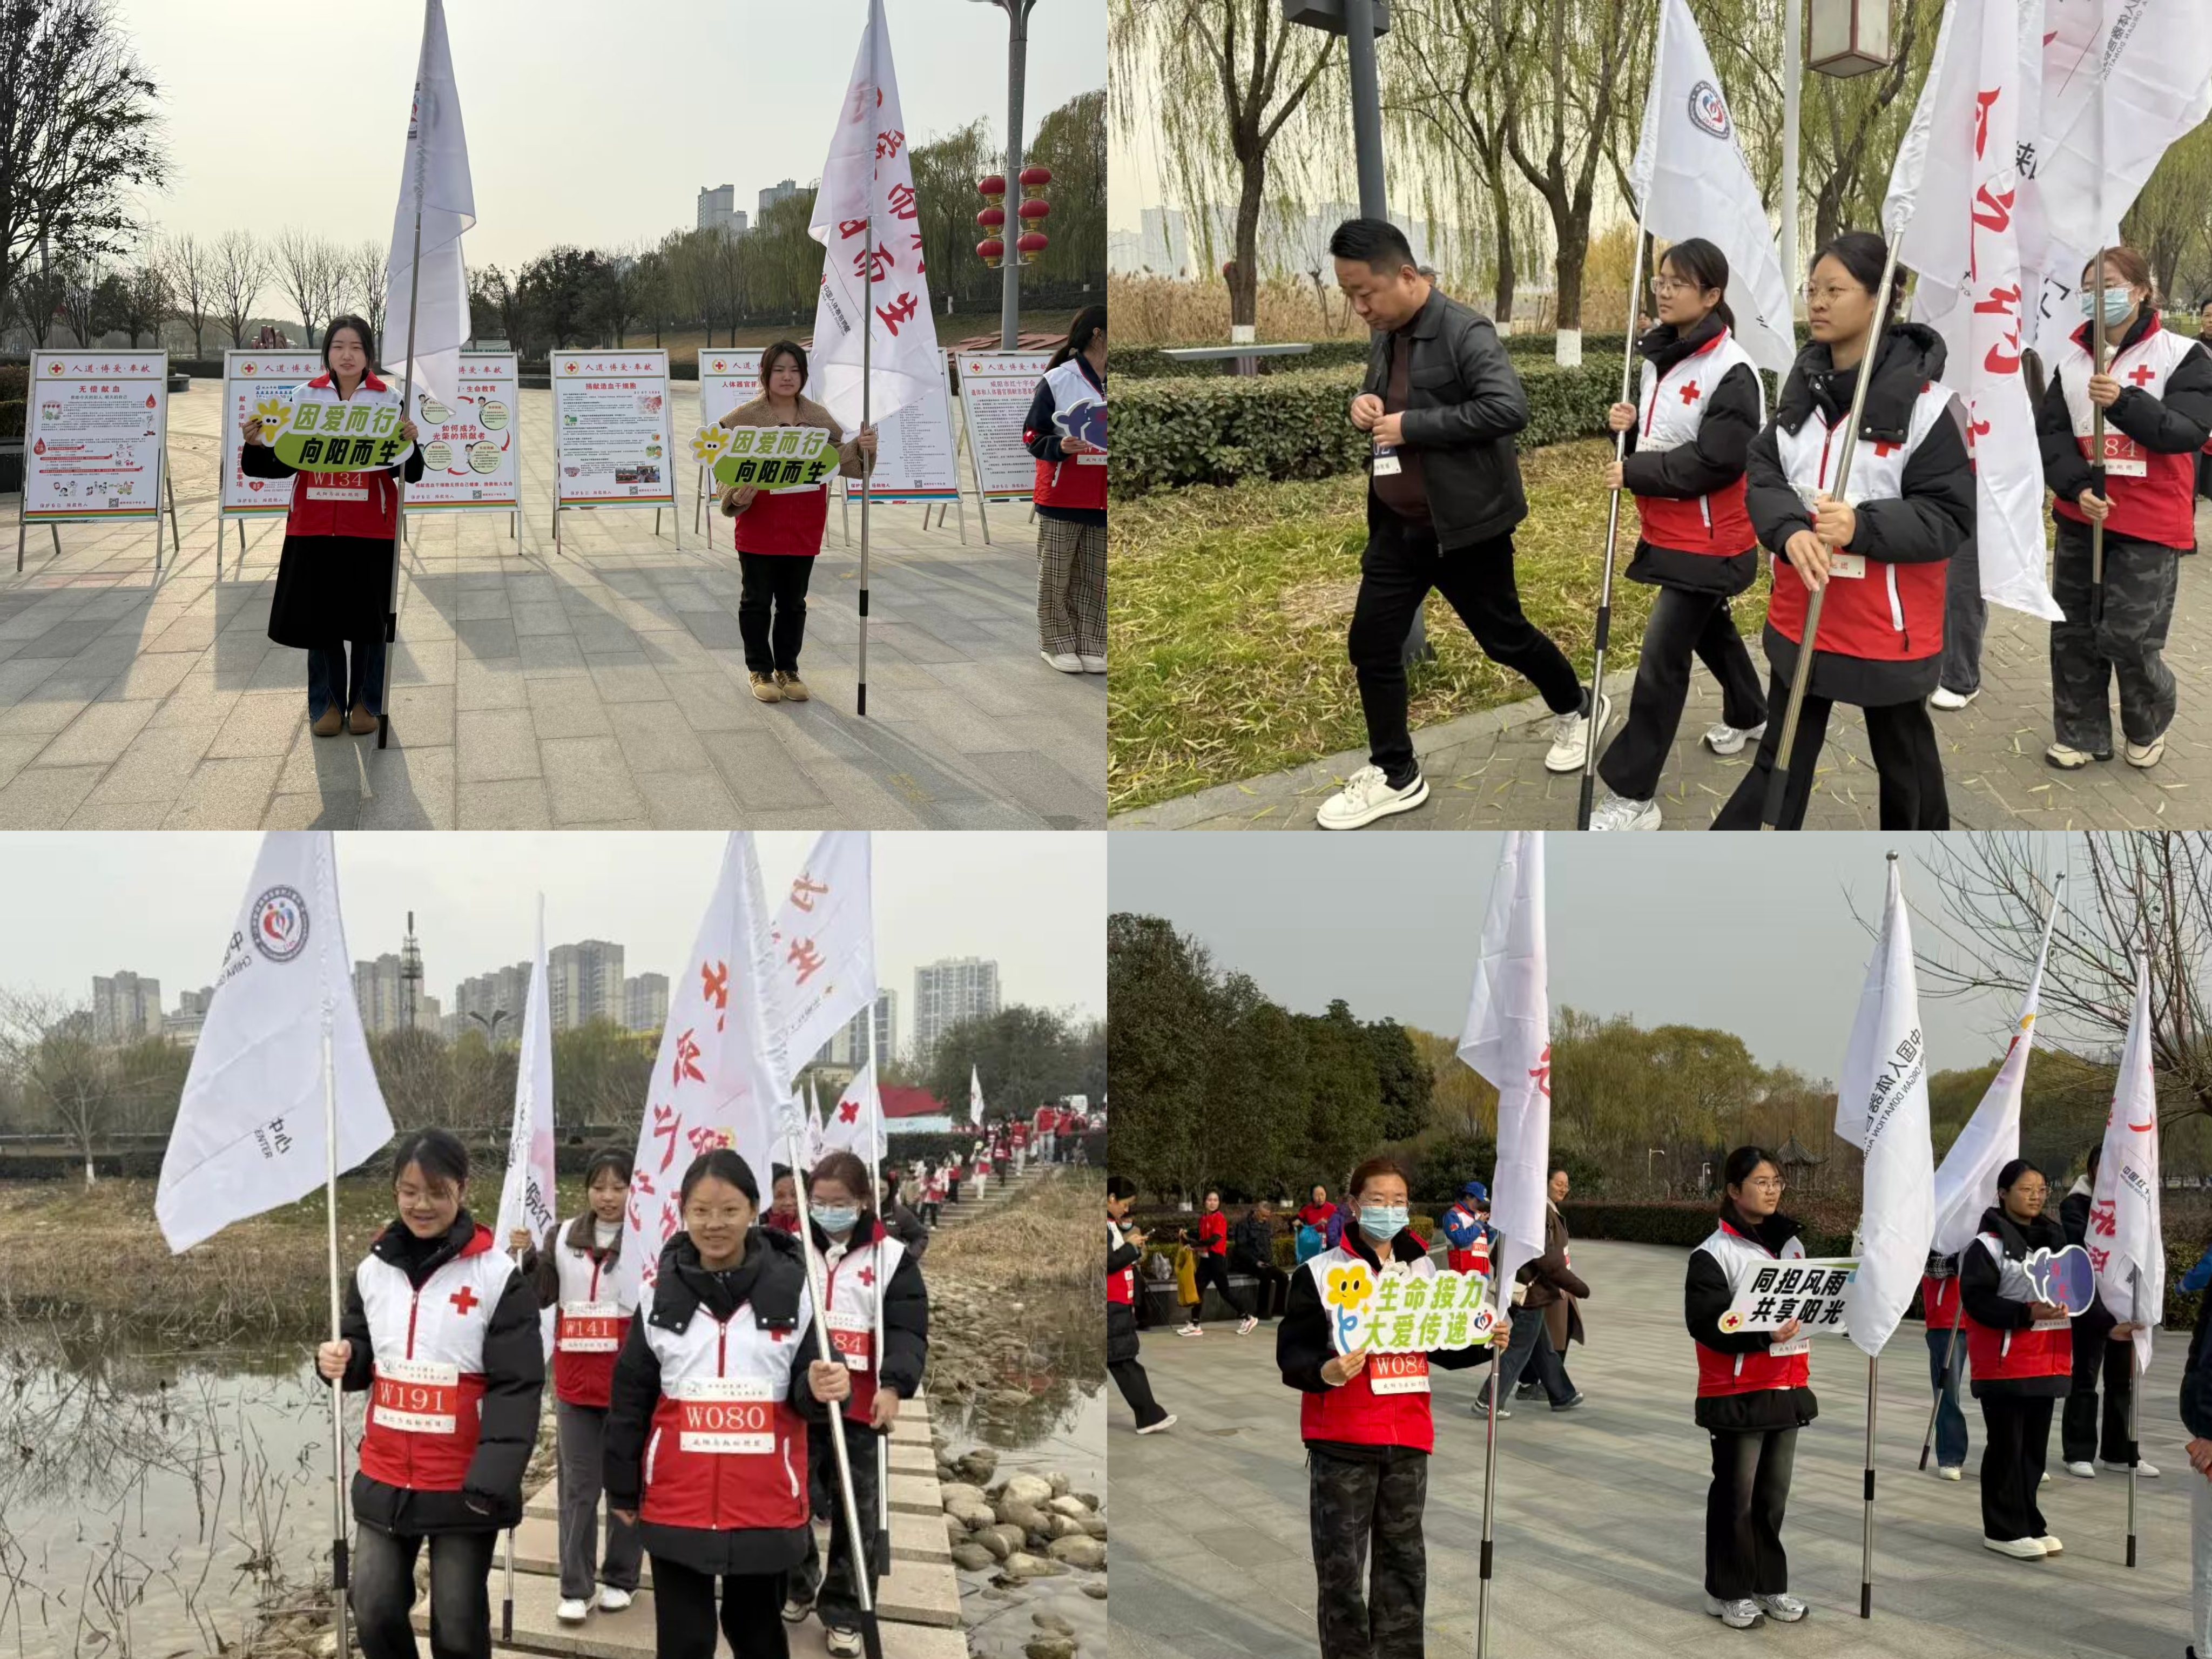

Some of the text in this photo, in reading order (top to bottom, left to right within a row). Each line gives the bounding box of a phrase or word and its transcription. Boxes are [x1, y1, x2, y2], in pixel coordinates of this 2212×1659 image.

[824, 285, 851, 333] 中国人体器官捐献
[72, 364, 151, 373] 人道·博爱·奉献
[264, 364, 326, 373] 人道·博爱·奉
[585, 363, 653, 372] 人道·博爱·奉献
[293, 404, 396, 432] 因爱而行
[299, 437, 400, 467] 向阳而生
[730, 430, 826, 455] 因爱而行
[2083, 438, 2137, 457] W84
[314, 472, 363, 487] W134
[735, 460, 827, 484] 向阳而生
[254, 1129, 272, 1159] ENTER
[269, 1116, 292, 1154] 中心
[2123, 1165, 2150, 1210] 中国红十
[1375, 1276, 1483, 1312] 生命接力
[1750, 1267, 1850, 1296] 同担风雨
[1749, 1297, 1846, 1324] 共享阳光
[566, 1320, 608, 1337] W141
[1360, 1313, 1469, 1348] 大爱传递
[1375, 1355, 1426, 1375] W084
[380, 1382, 444, 1412] W191
[686, 1406, 765, 1429] W080
